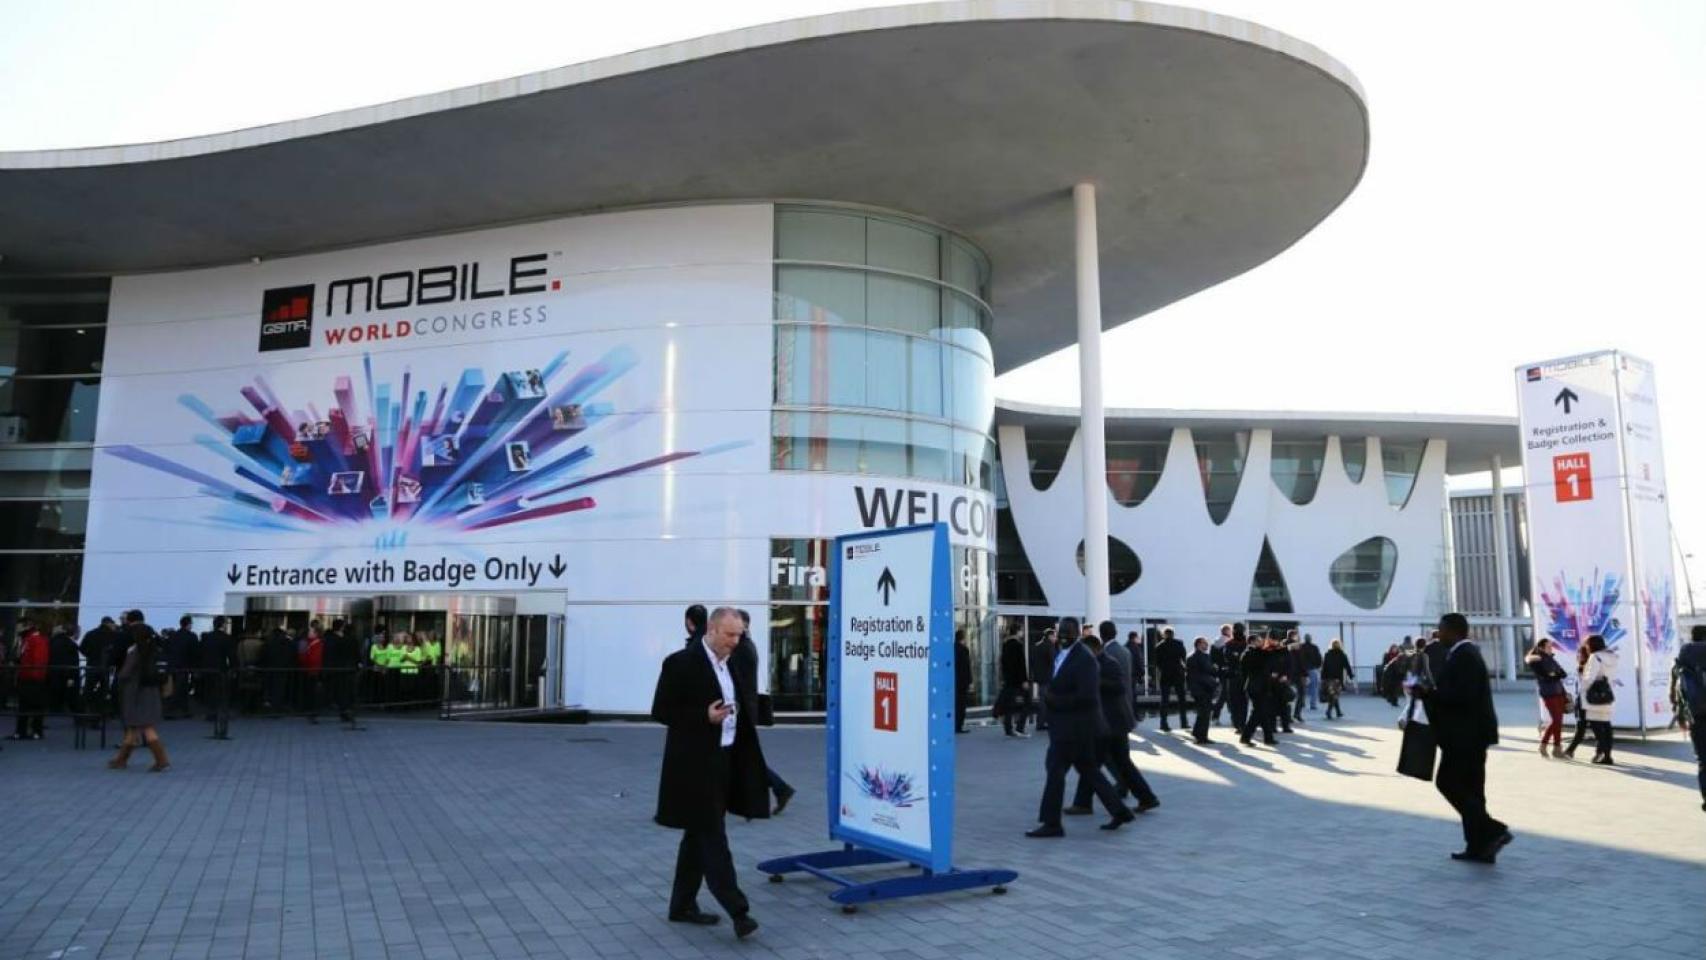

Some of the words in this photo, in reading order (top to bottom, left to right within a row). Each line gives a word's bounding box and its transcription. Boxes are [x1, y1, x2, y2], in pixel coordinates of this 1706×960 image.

[1533, 421, 1595, 437] Registration
[1598, 417, 1607, 428] &
[1527, 439, 1560, 450] Badge
[1562, 431, 1614, 446] Collection
[1556, 456, 1587, 472] HALL
[1566, 473, 1579, 497] 1
[246, 564, 337, 586] Entrance
[345, 561, 394, 583] with
[403, 557, 477, 587] Badge
[484, 555, 543, 587] Only
[770, 557, 826, 587] Fira
[851, 616, 913, 636] Registration
[916, 616, 925, 632] &
[845, 641, 876, 661] Badge
[876, 677, 895, 691] HALL
[881, 697, 890, 725] 1
